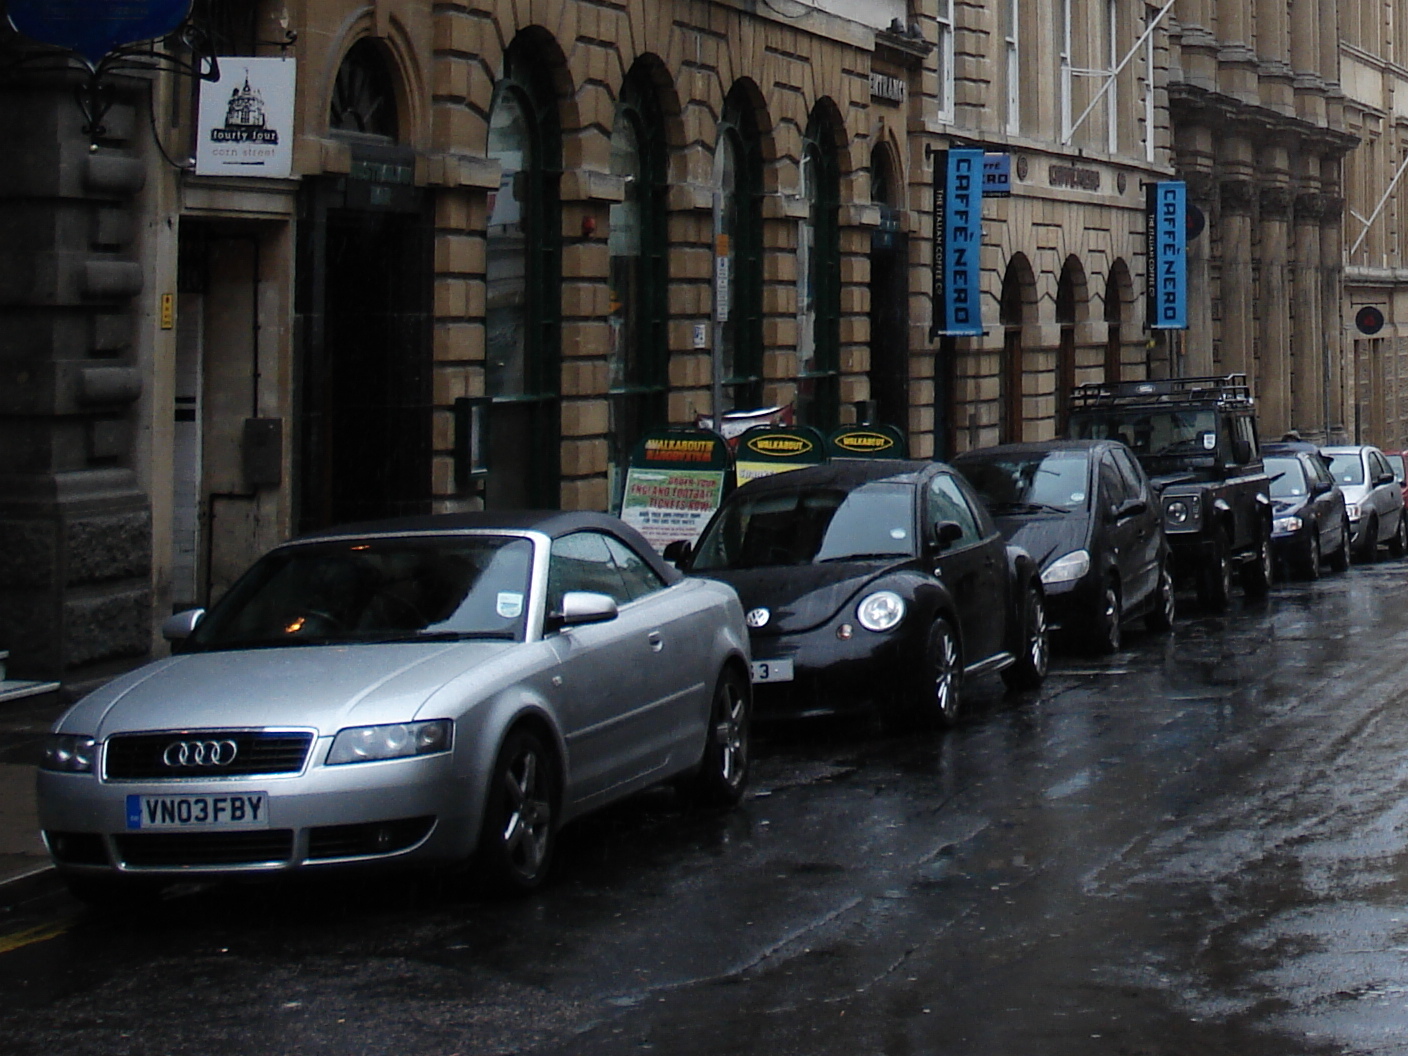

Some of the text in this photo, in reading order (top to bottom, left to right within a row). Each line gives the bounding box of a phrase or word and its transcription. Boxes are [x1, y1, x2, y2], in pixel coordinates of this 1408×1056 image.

[213, 130, 277, 142] fourty four
[212, 148, 276, 157] corn street
[936, 189, 944, 206] THE
[935, 207, 943, 250] ITALIAN
[935, 251, 943, 280] COFFEE
[953, 248, 970, 324] NERO
[1163, 260, 1176, 320] NERO
[757, 440, 803, 450] WALKABOUT
[843, 437, 885, 446] WALKABOUT
[631, 484, 670, 497] ENGLAND
